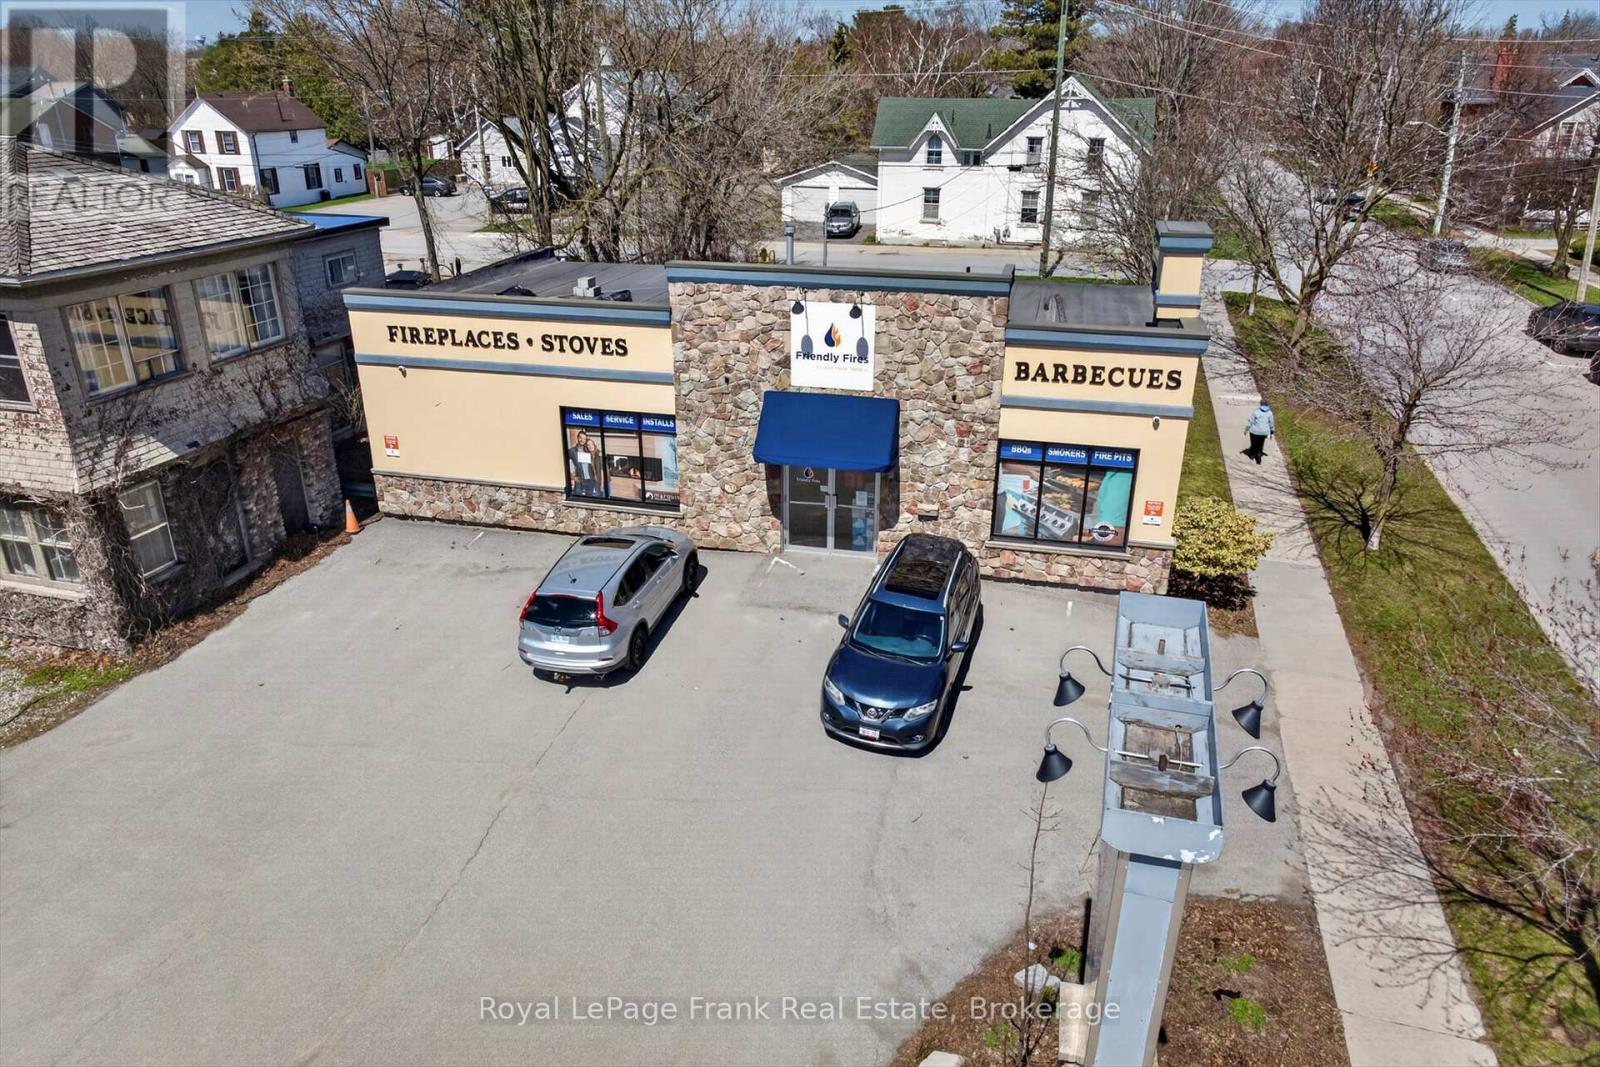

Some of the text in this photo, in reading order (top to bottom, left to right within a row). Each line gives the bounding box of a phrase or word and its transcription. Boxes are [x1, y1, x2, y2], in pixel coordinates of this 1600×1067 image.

[387, 325, 629, 356] FIREPLACES STOVES
[795, 350, 869, 364] Friendly Fires
[1014, 361, 1183, 391] BARBECUES
[572, 411, 593, 421] SALES
[605, 414, 635, 424] SERVICE
[642, 417, 675, 428] INSTALLS
[1047, 447, 1086, 459] SMOKERS
[1094, 450, 1132, 463] FIRE PITS
